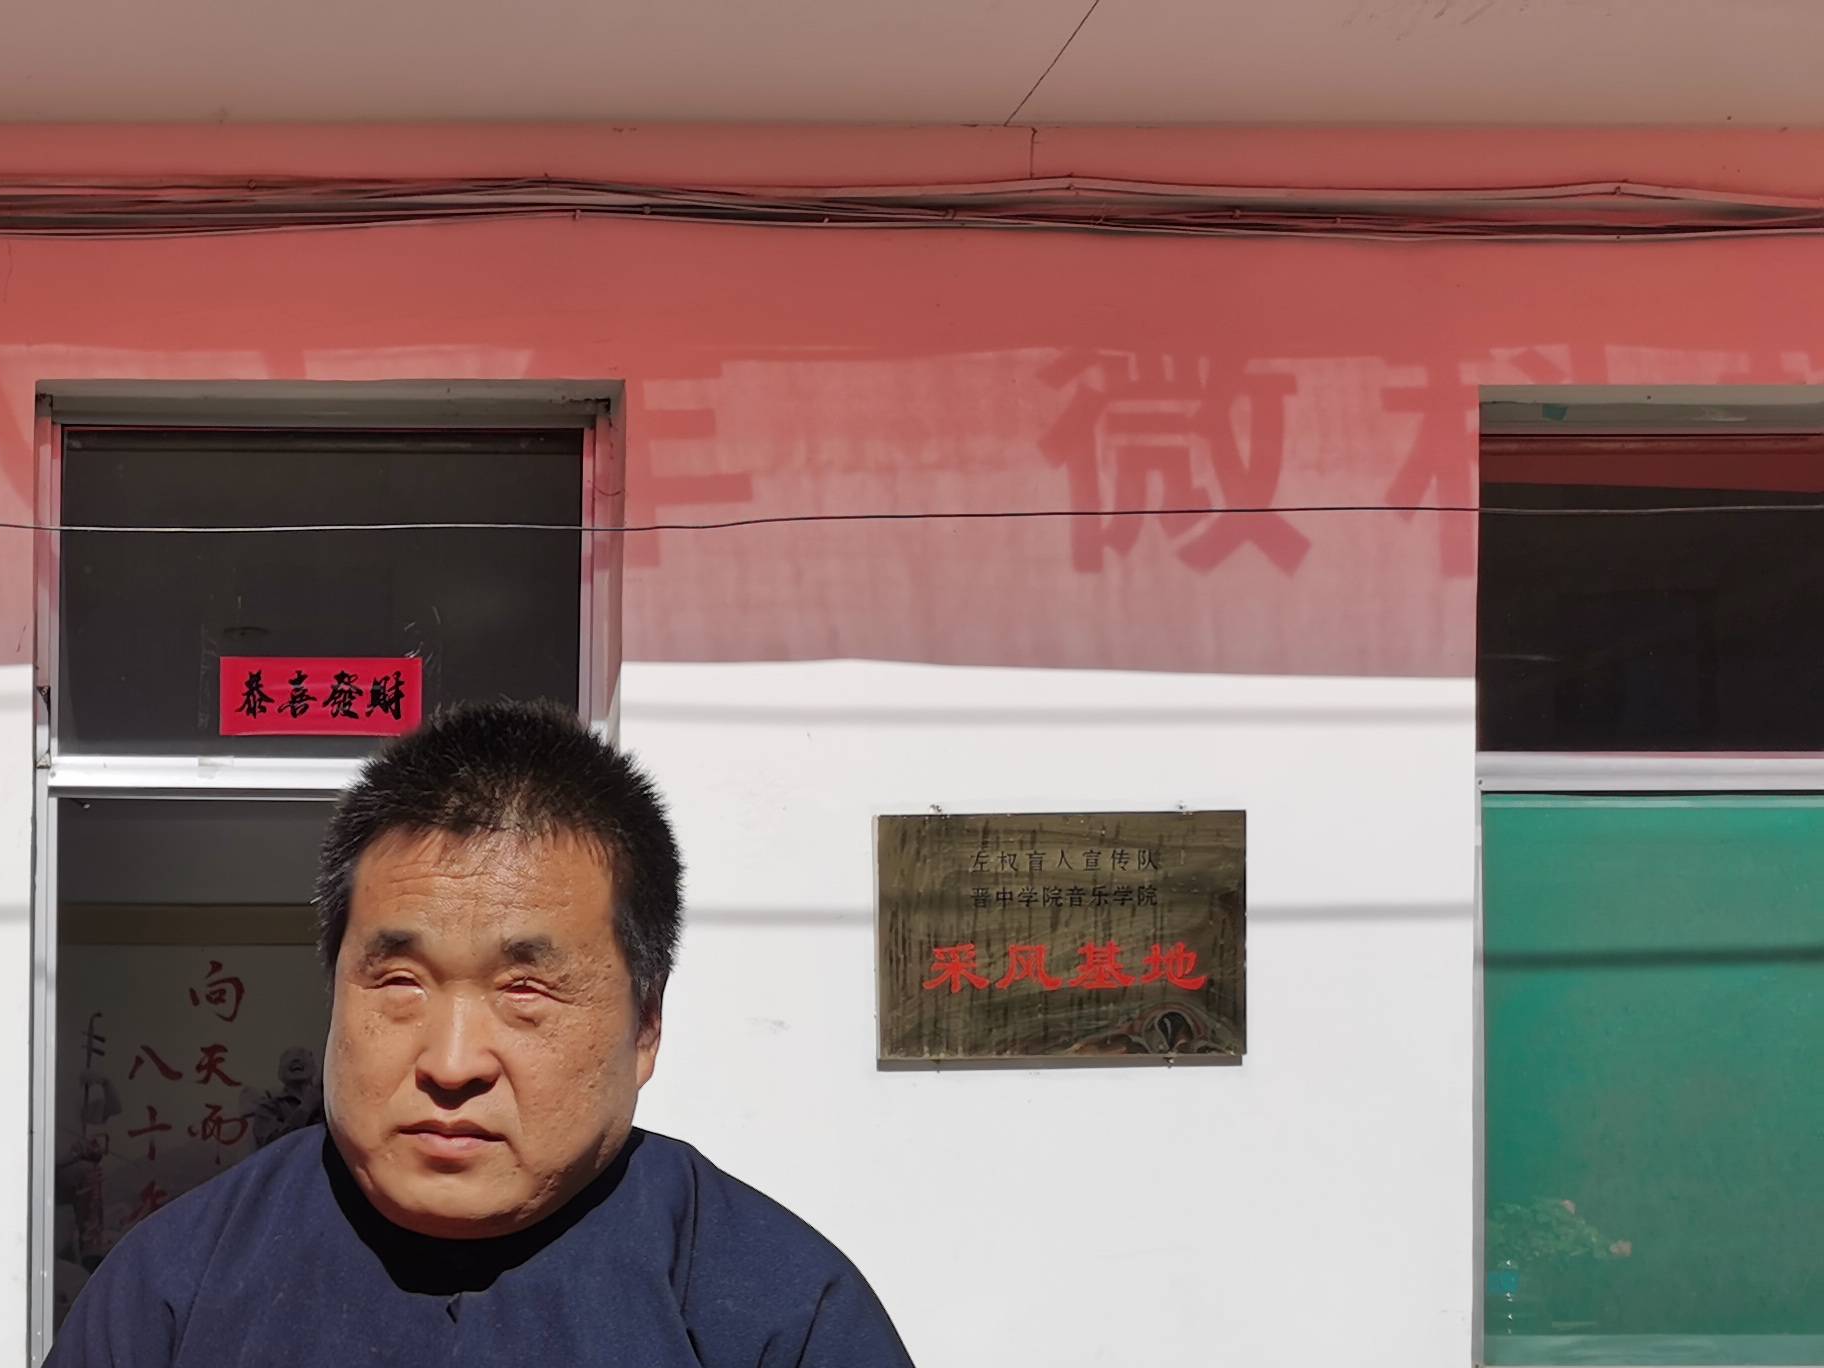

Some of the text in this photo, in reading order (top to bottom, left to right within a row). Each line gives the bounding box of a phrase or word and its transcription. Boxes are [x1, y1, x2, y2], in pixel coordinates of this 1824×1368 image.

[235, 669, 406, 721] 恭喜發財
[969, 849, 1159, 873] 左权盲人宣传队
[970, 885, 1158, 908] 晋中学院音乐学院
[922, 940, 1207, 993] 采风基地
